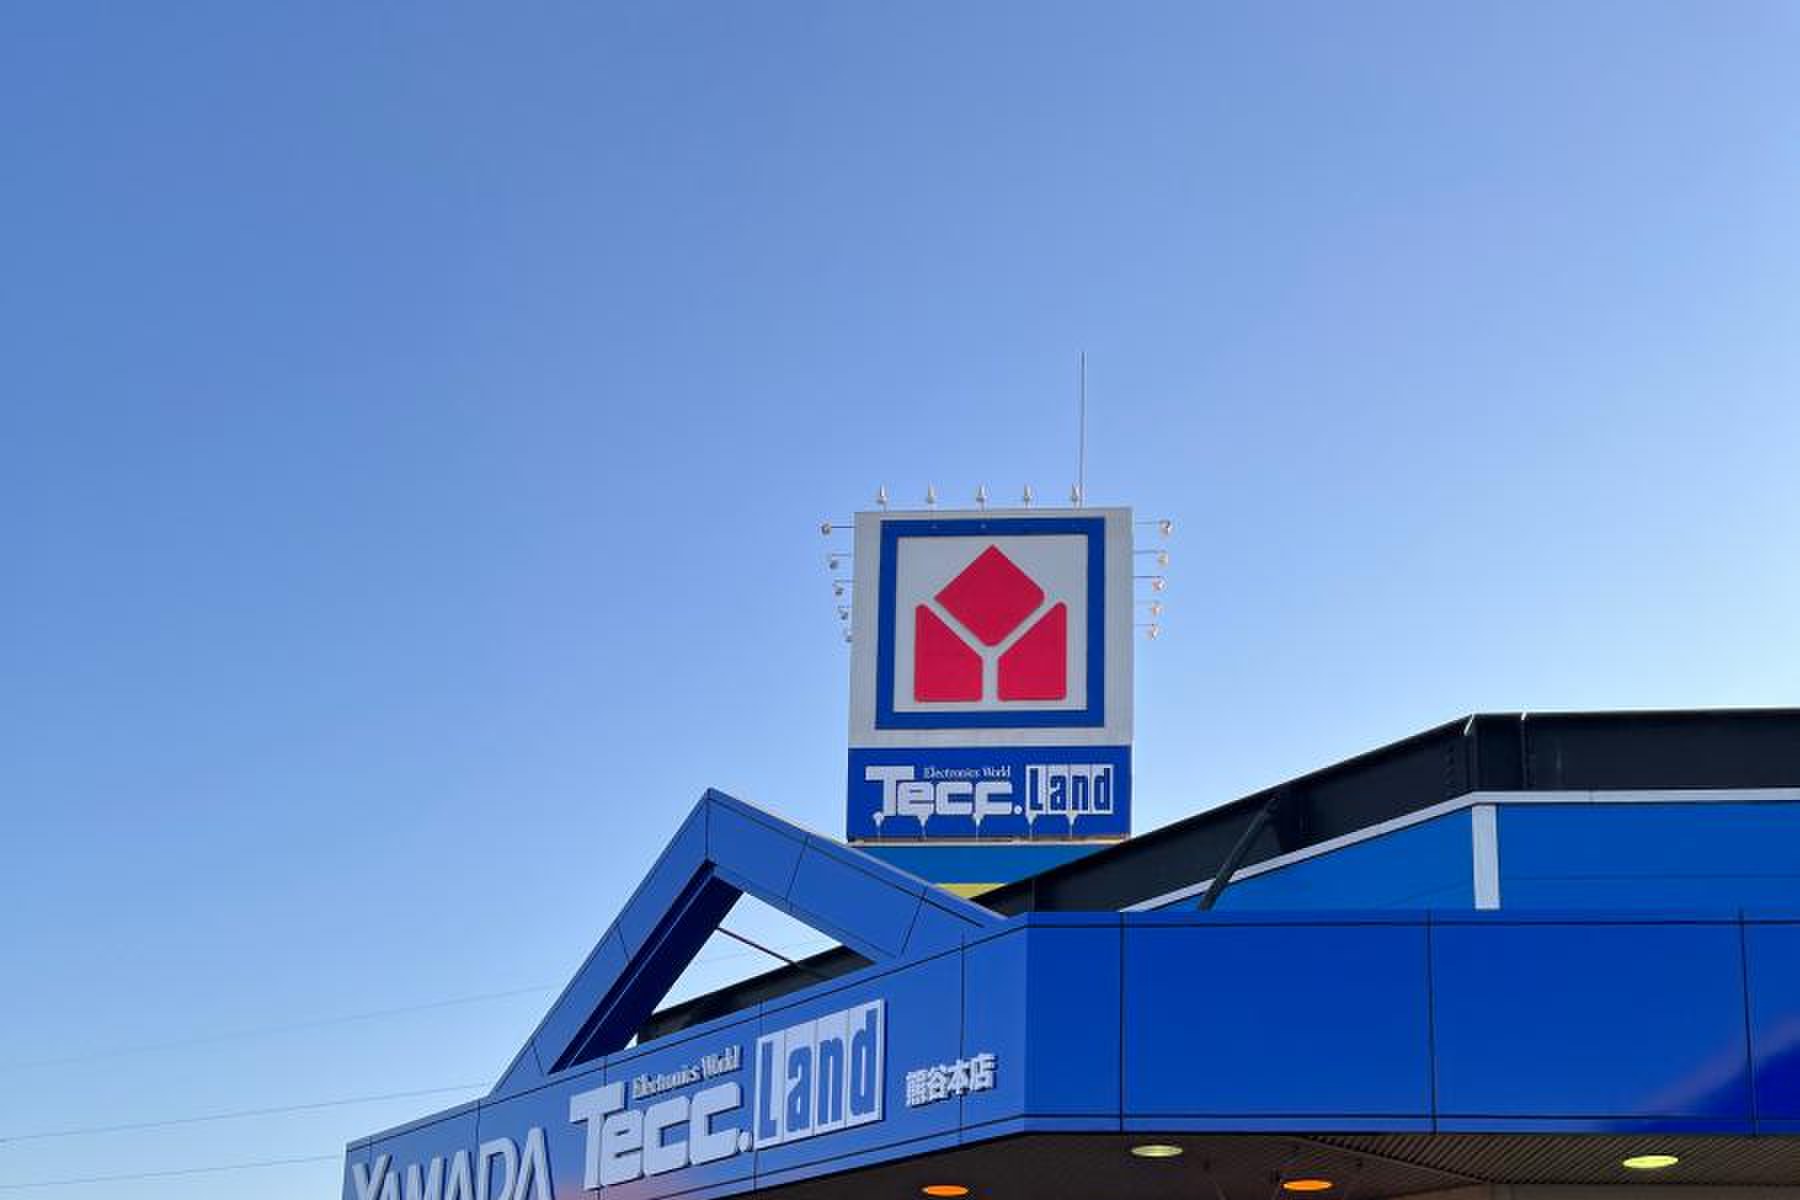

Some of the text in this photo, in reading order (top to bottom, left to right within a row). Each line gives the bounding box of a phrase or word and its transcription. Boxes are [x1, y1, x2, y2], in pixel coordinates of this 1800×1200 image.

[924, 765, 1011, 778] Electronics World
[905, 1053, 996, 1107] 熊谷本店
